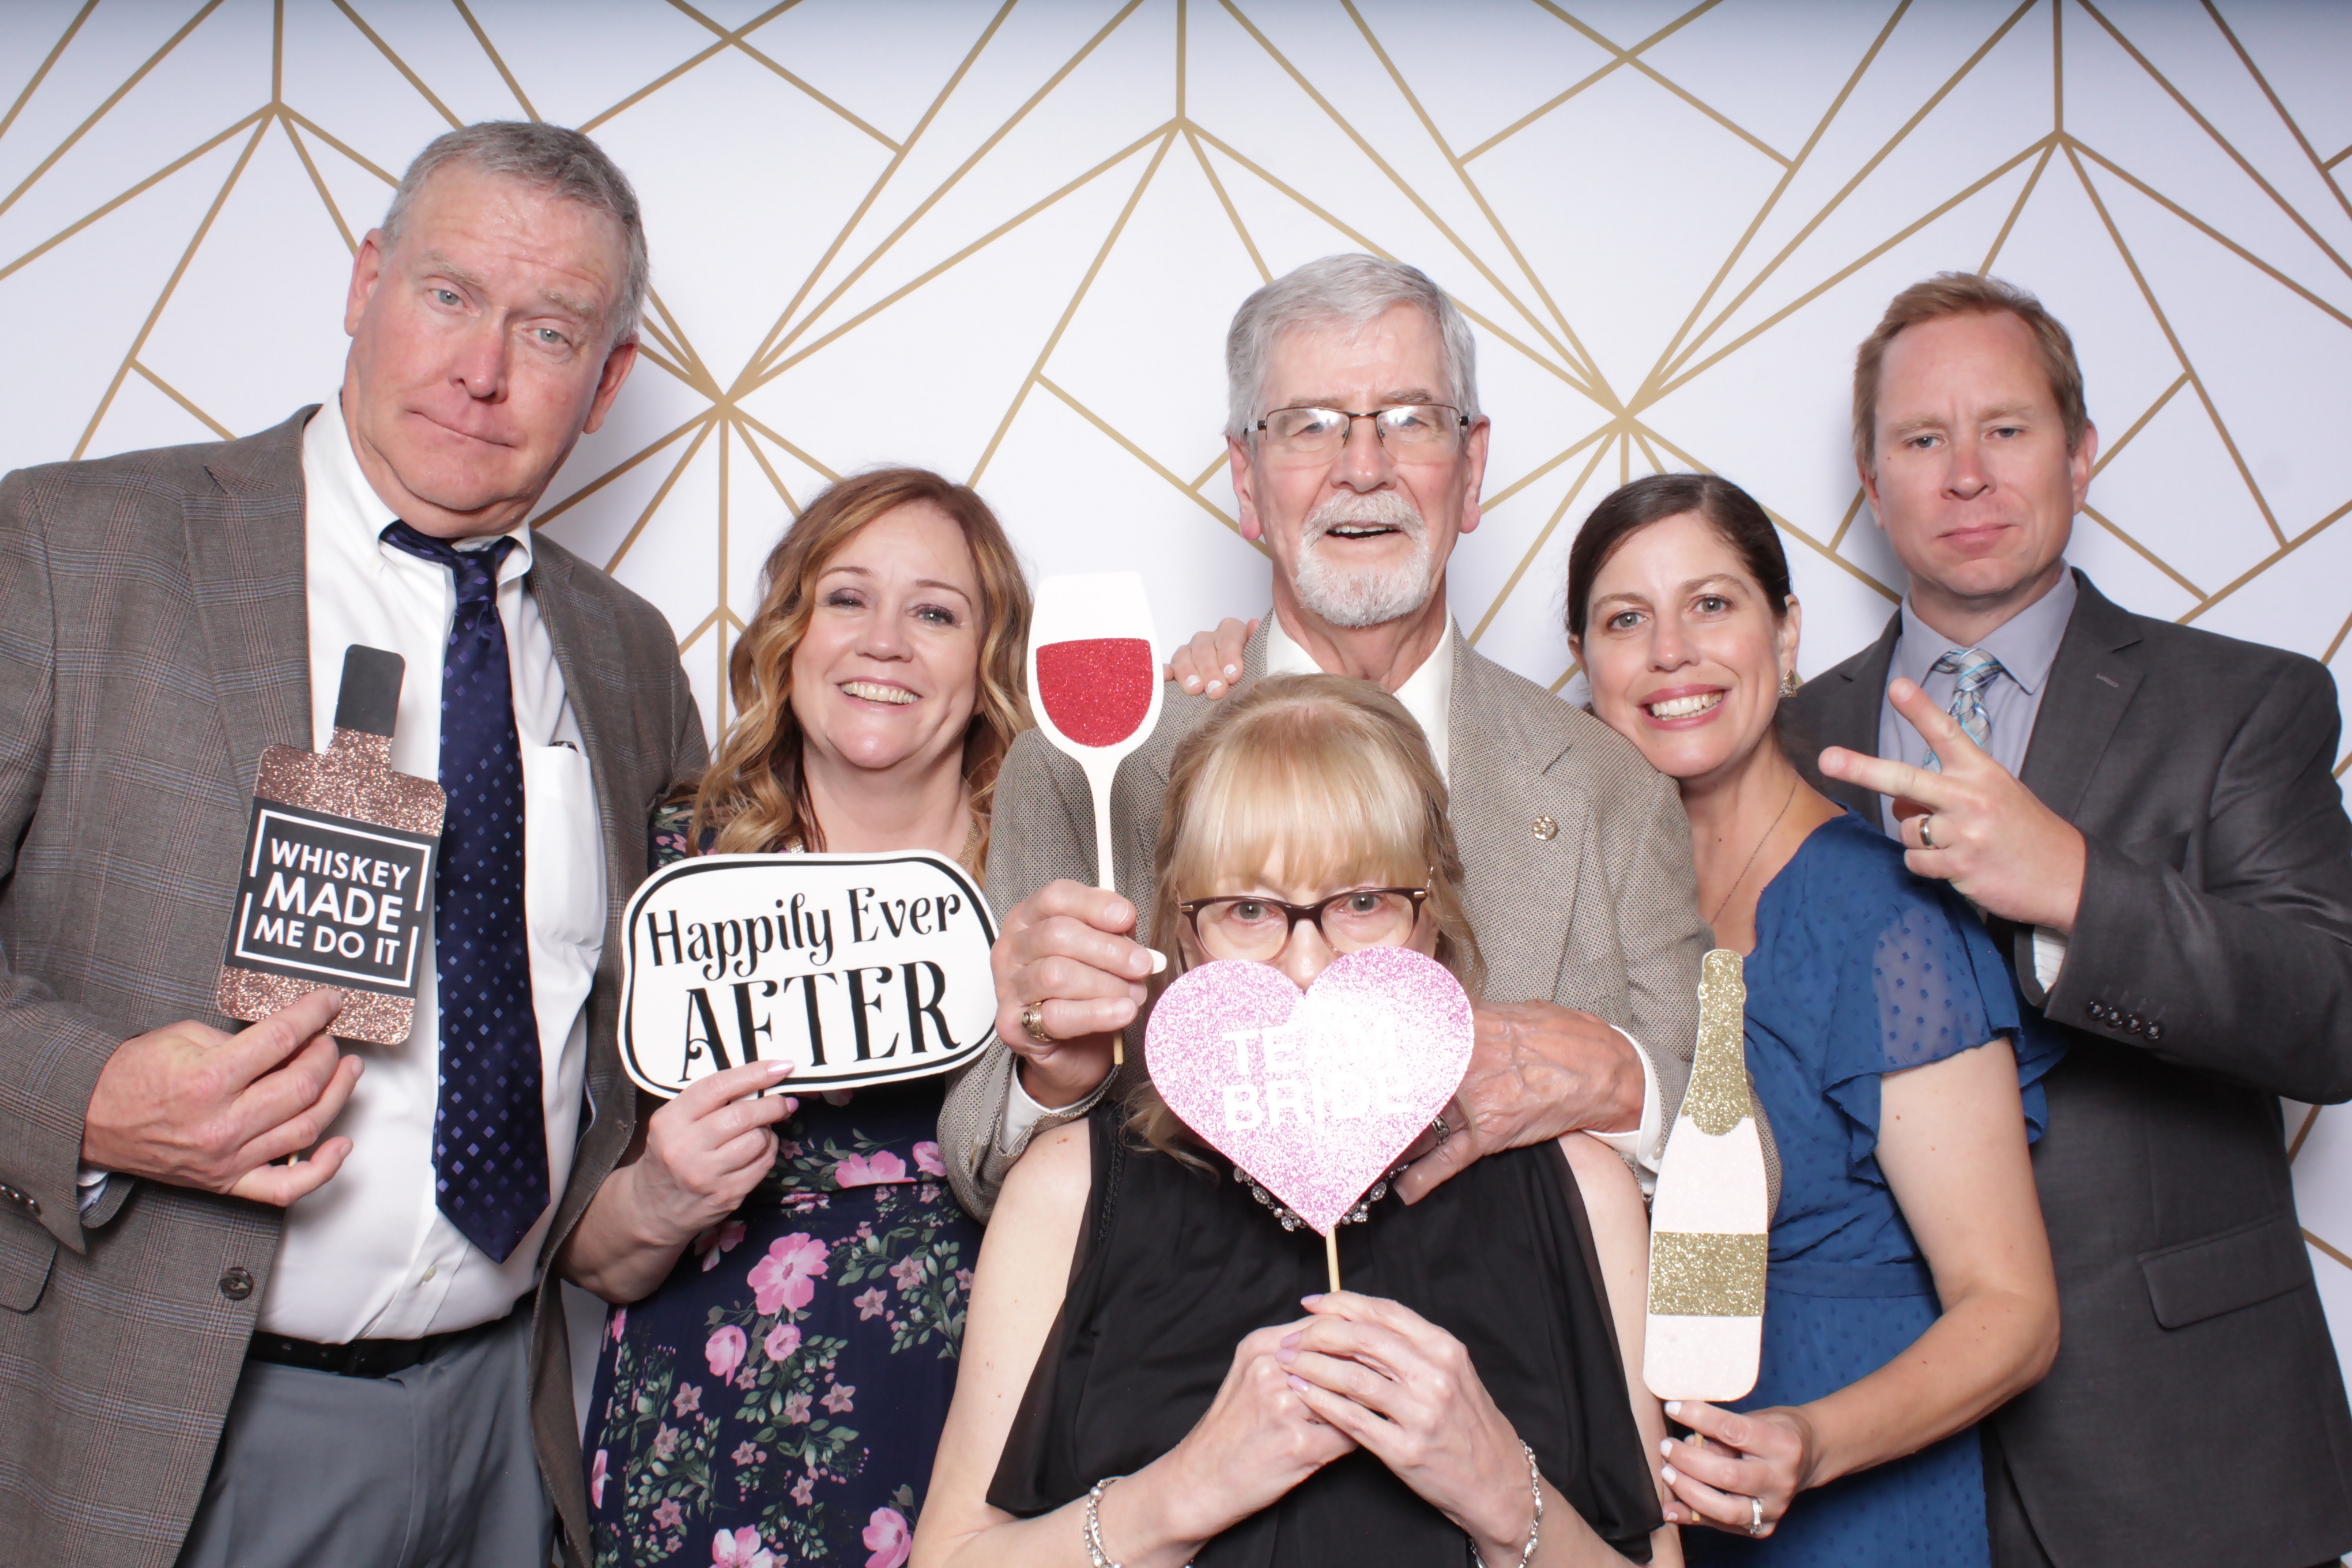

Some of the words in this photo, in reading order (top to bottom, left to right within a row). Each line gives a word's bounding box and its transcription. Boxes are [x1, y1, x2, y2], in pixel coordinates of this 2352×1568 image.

[272, 837, 410, 891] WHISKEY
[262, 872, 403, 933] MADE
[253, 915, 304, 948] ME
[314, 926, 365, 958] DO
[374, 937, 400, 965] IT
[647, 893, 834, 981] Happily
[847, 887, 961, 943] Ever
[678, 960, 961, 1082] AFTER
[1223, 1016, 1397, 1075] TEAM
[1224, 1070, 1414, 1131] BRIDE
